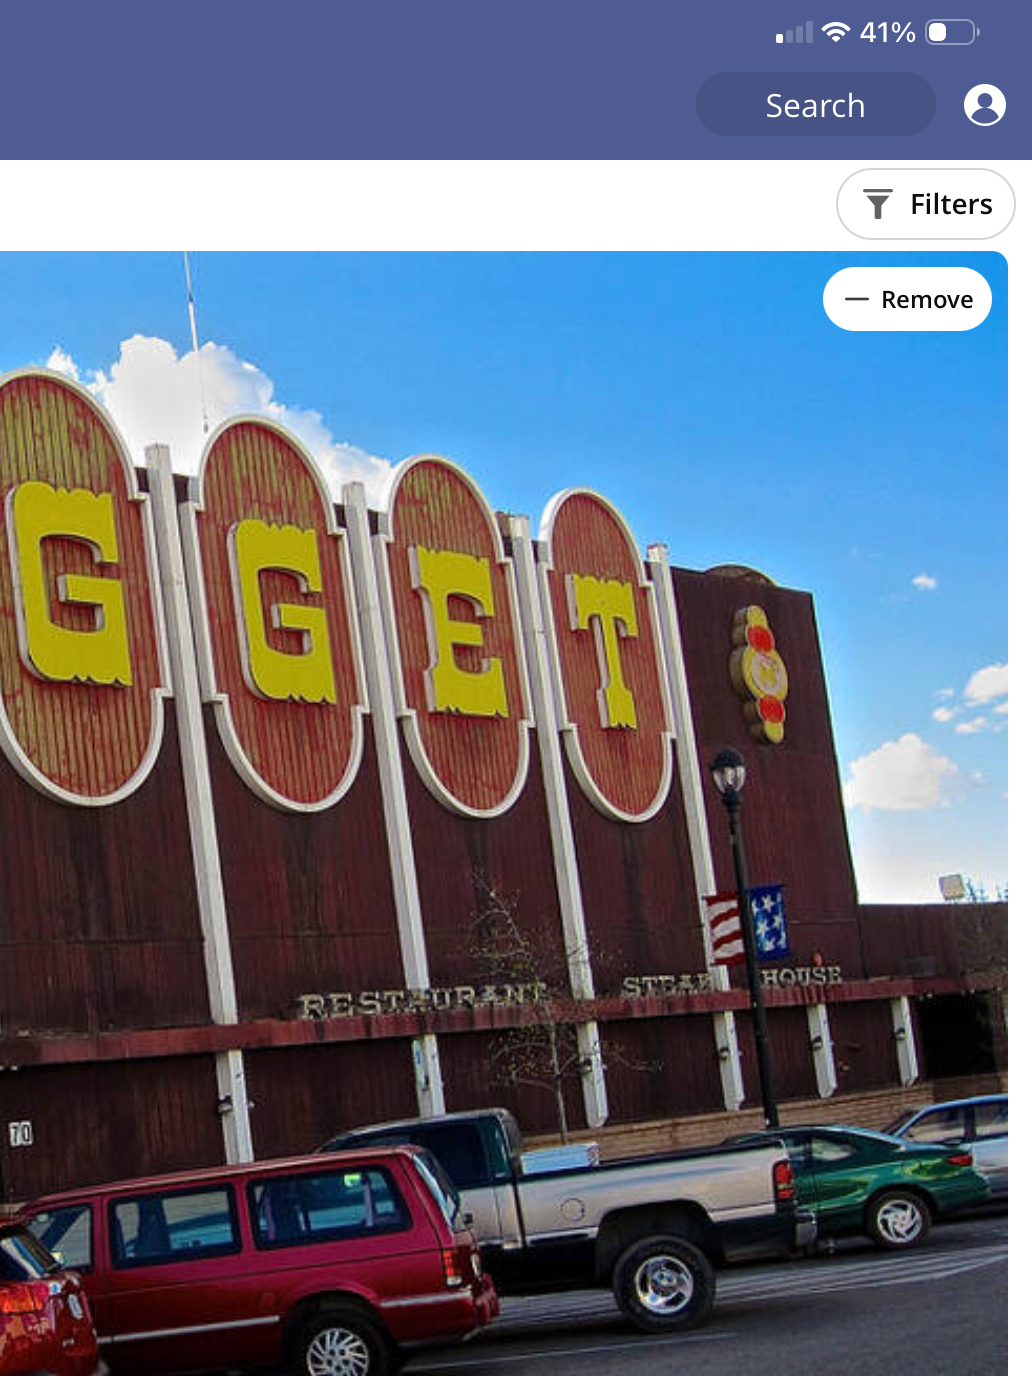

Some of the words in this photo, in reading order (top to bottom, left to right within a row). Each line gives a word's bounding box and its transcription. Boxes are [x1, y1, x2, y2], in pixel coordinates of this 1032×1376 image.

[859, 21, 916, 43] 41%
[766, 91, 865, 119] Search
[911, 191, 993, 216] Filters
[882, 290, 974, 310] Remove
[300, 982, 548, 1019] RESTAURANT
[761, 965, 843, 989] HOUSE
[11, 1124, 31, 1144] 70
